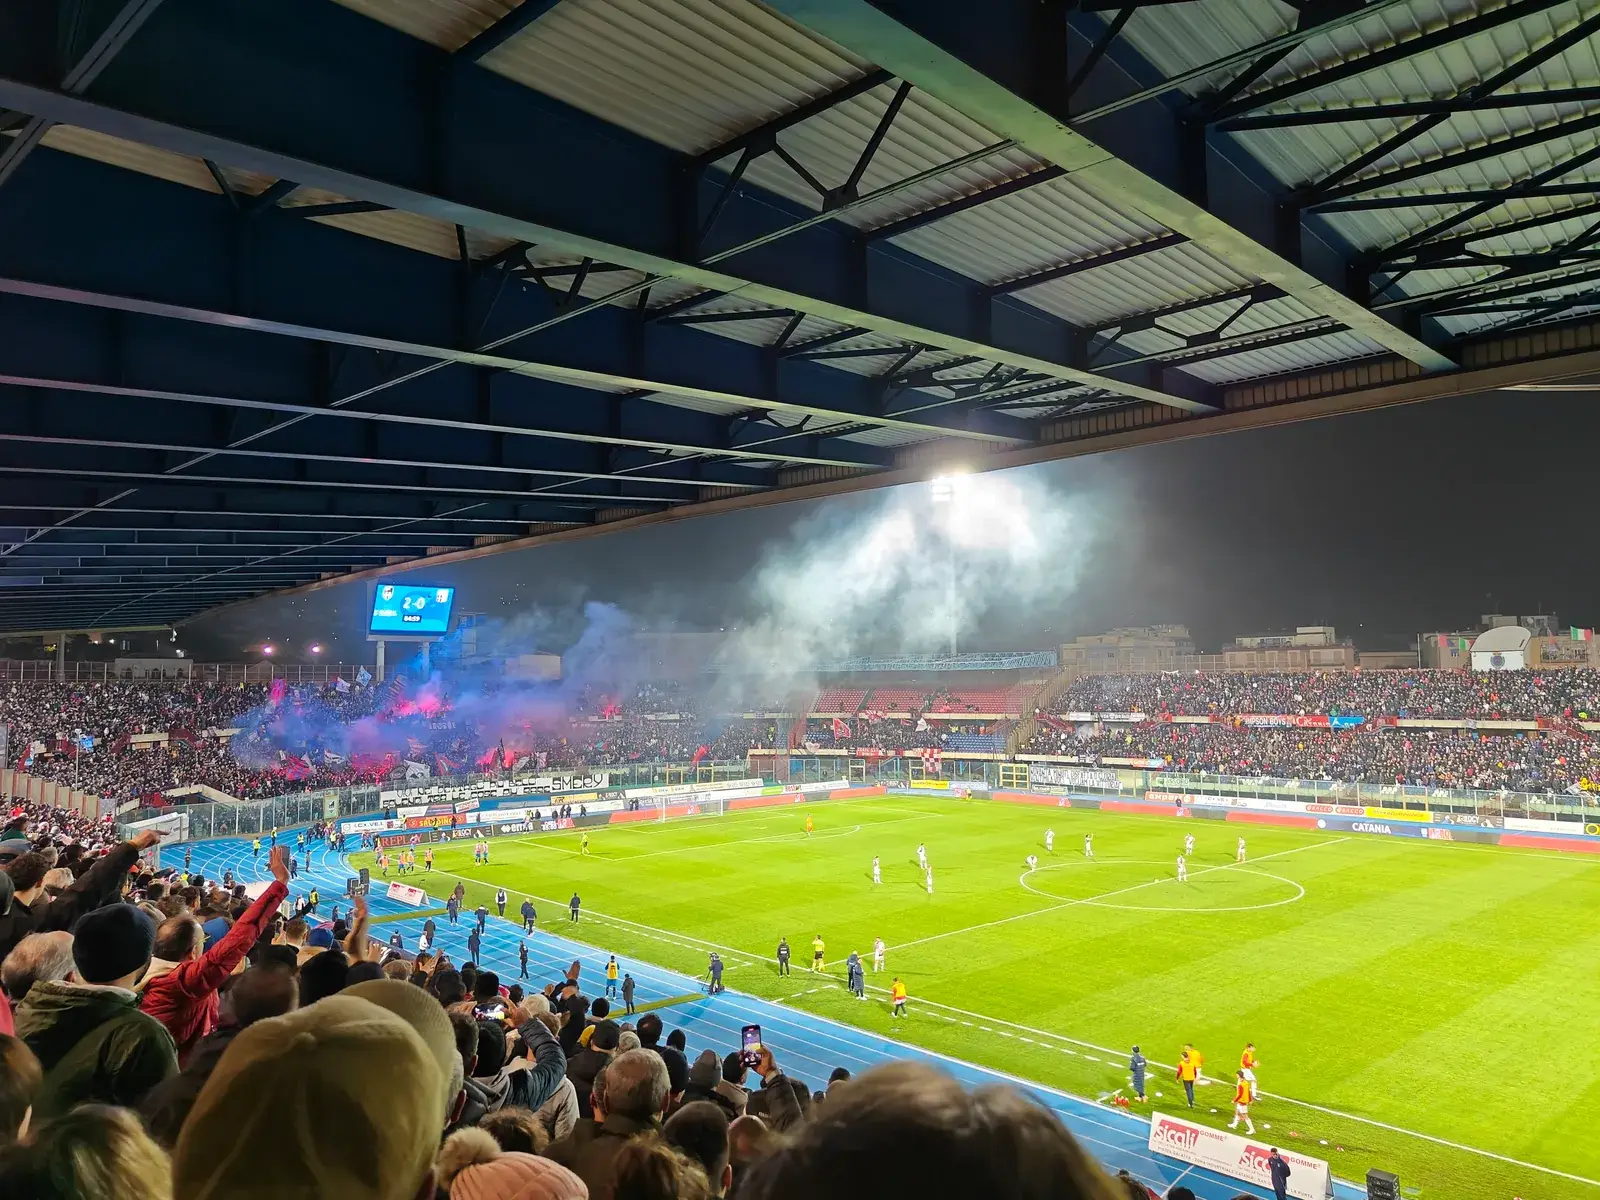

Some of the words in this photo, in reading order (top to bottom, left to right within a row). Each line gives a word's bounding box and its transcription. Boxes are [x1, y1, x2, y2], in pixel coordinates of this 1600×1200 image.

[1352, 822, 1391, 834] CATANIA
[381, 833, 423, 847] REPLY
[1297, 1191, 1314, 1199] PUNTA
